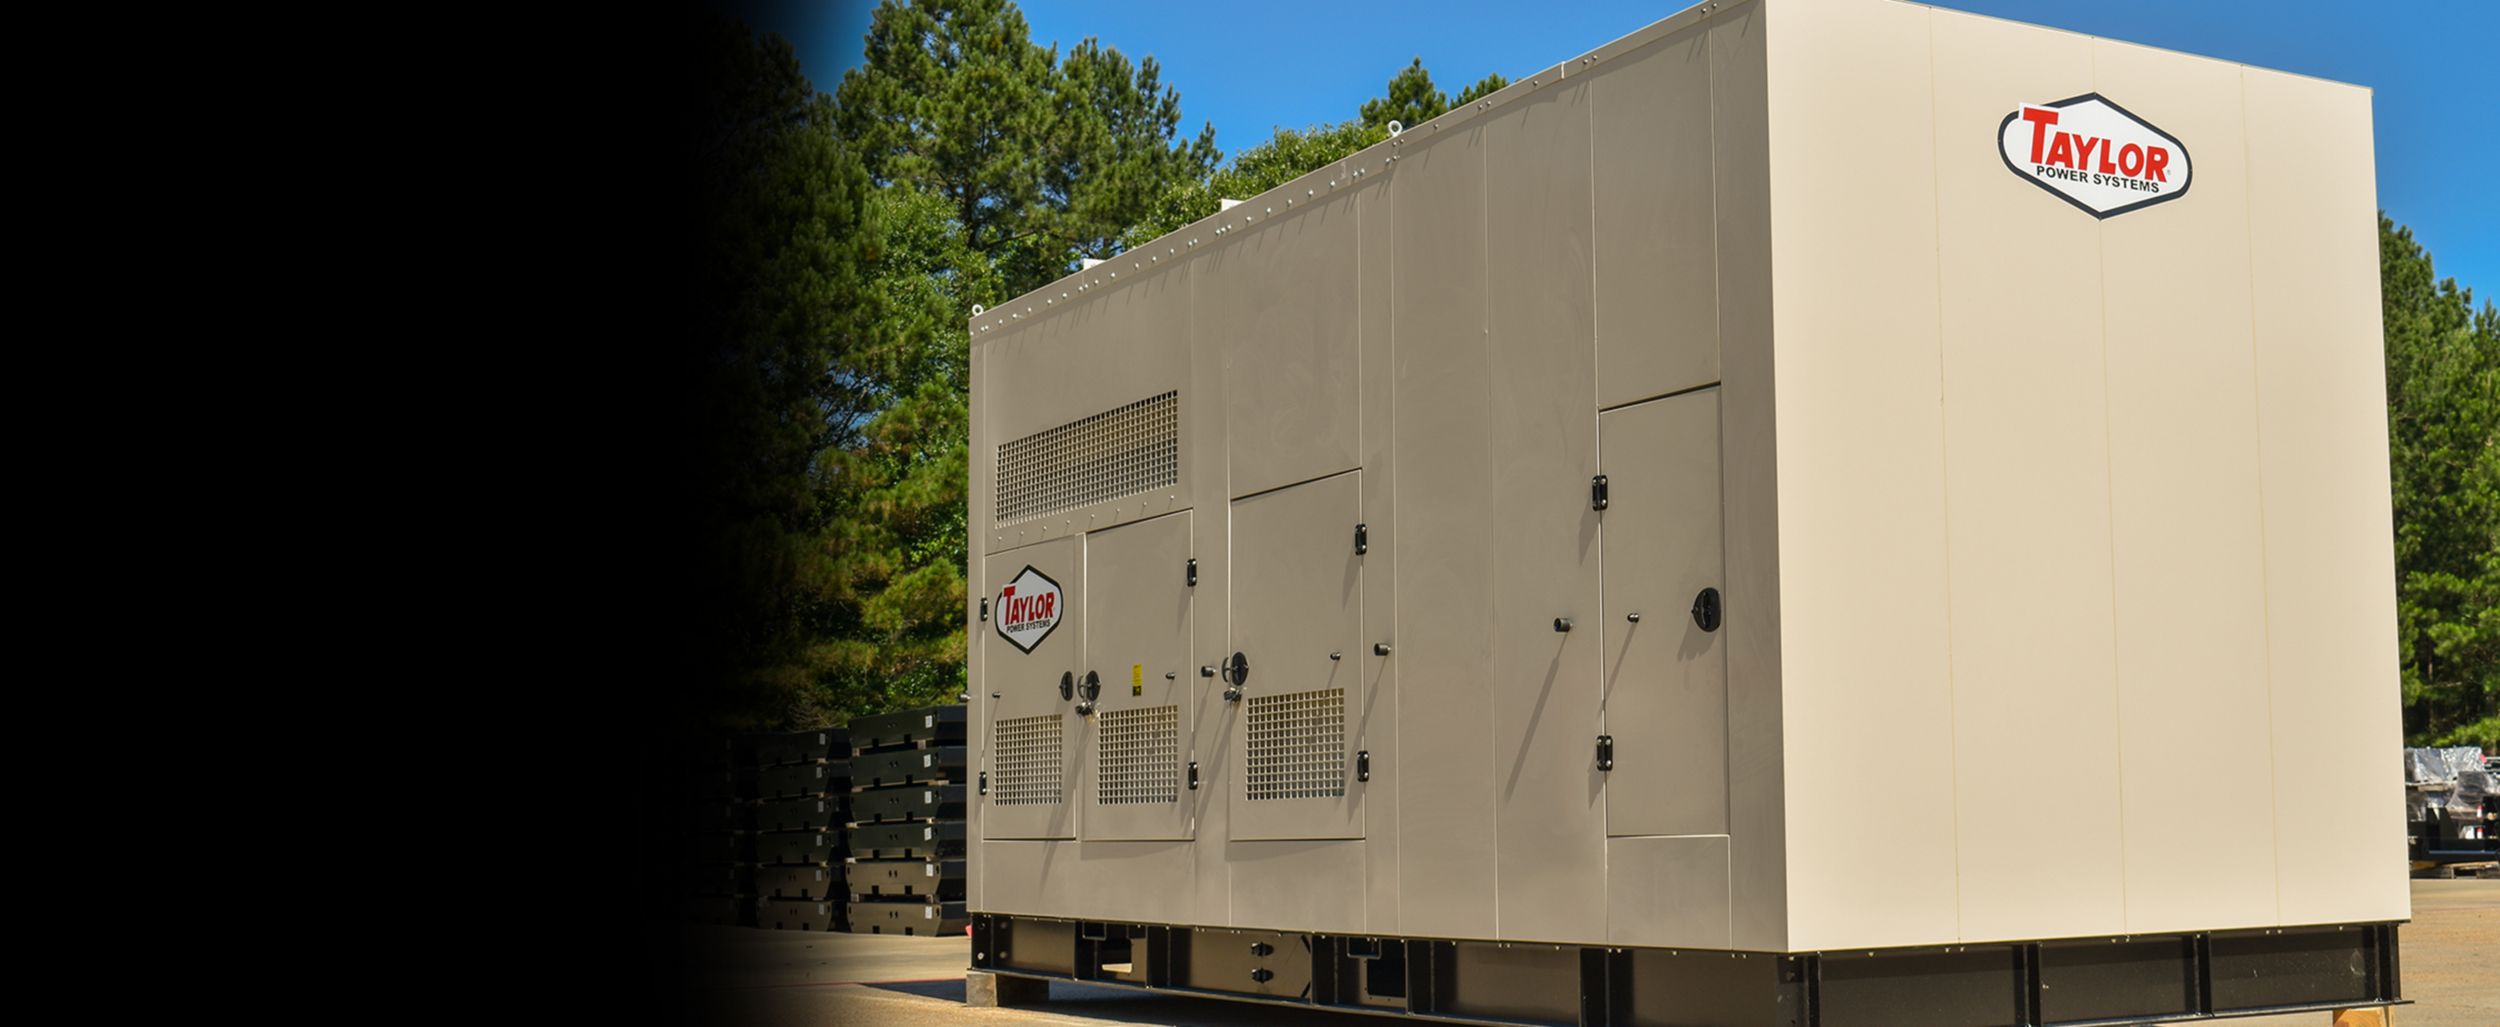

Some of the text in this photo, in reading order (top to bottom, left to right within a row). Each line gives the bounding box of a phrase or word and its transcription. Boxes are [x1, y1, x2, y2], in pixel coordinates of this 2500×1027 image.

[2023, 107, 2169, 183] TAYLOR
[2036, 166, 2160, 193] POWER SYSTEMS
[1003, 586, 1054, 625] TAYLOR
[1006, 619, 1051, 633] POWER SYSTEMS
